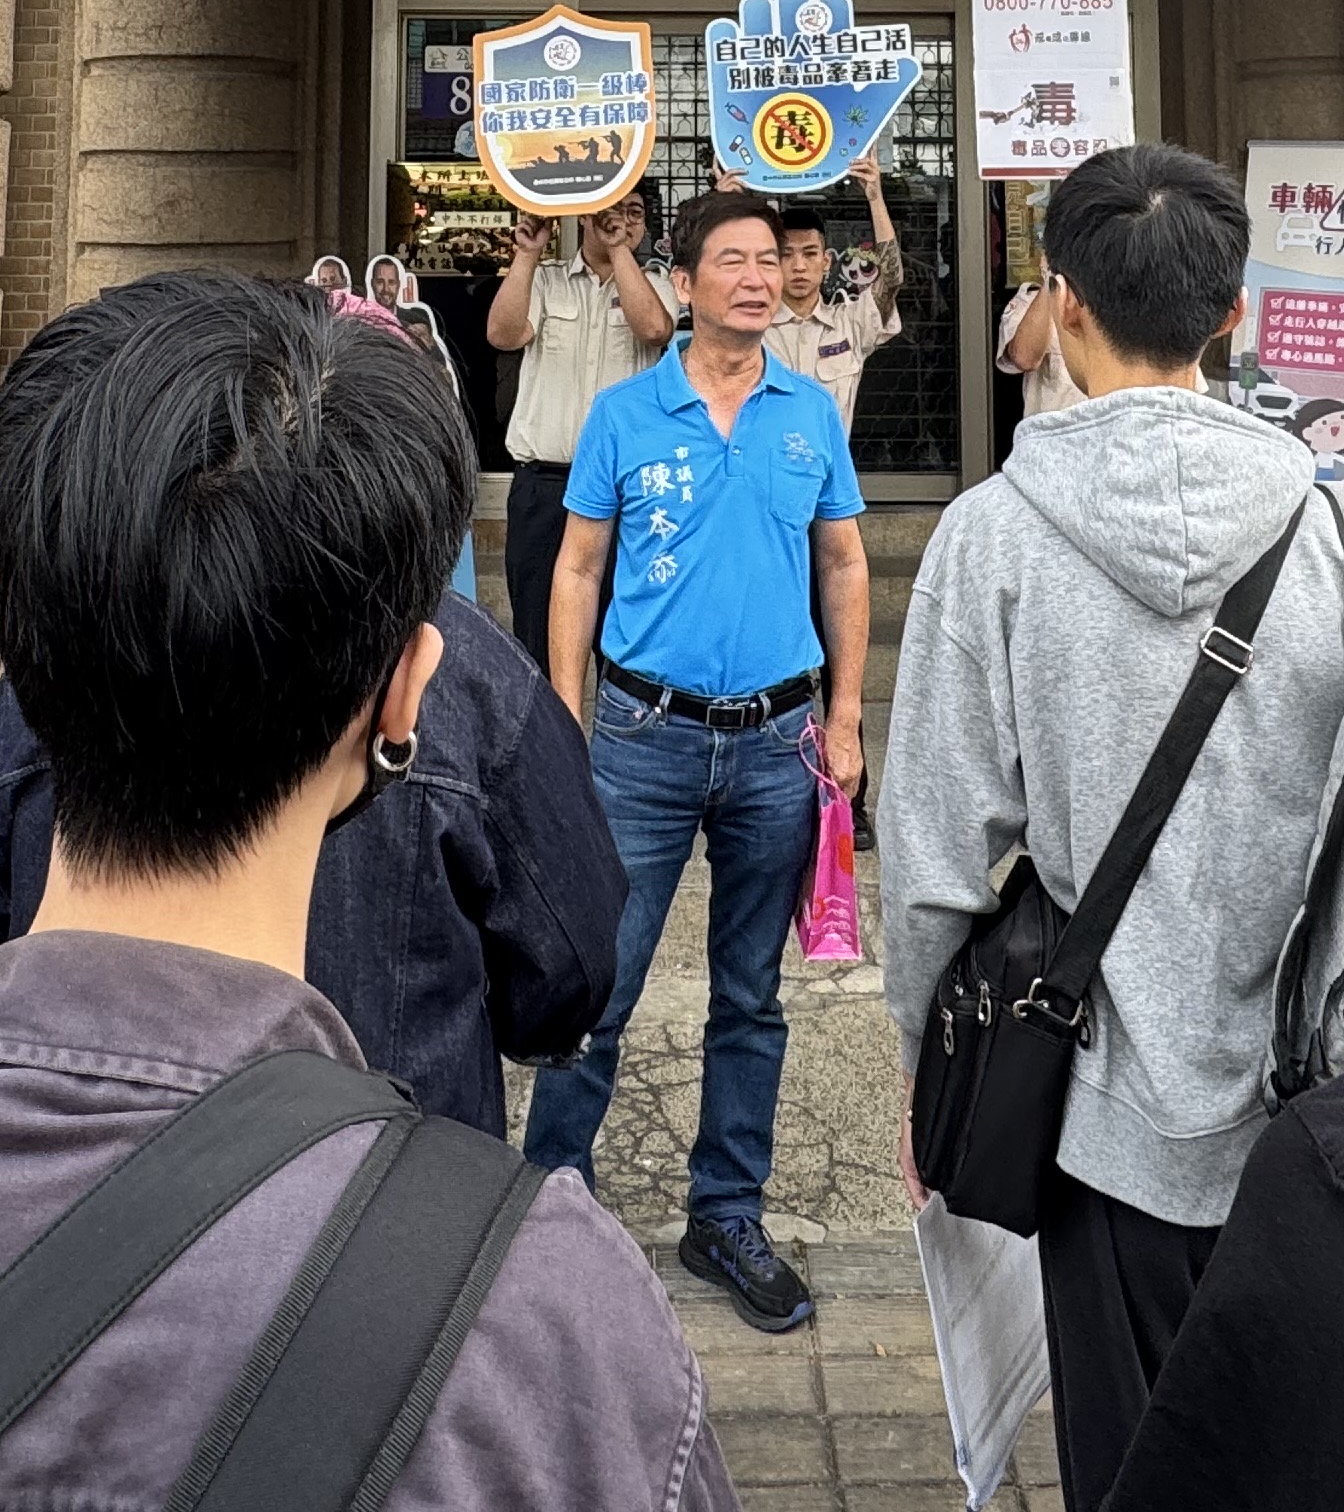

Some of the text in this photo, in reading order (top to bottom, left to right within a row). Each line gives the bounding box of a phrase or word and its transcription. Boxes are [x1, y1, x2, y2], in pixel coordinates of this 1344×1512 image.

[716, 28, 907, 61] 自己的人生自己活
[481, 73, 648, 104] 國家防衛一級棒
[729, 58, 898, 89] 別被毒品牽著走
[482, 102, 649, 134] 你我安全有保障
[1030, 81, 1077, 126] 毒
